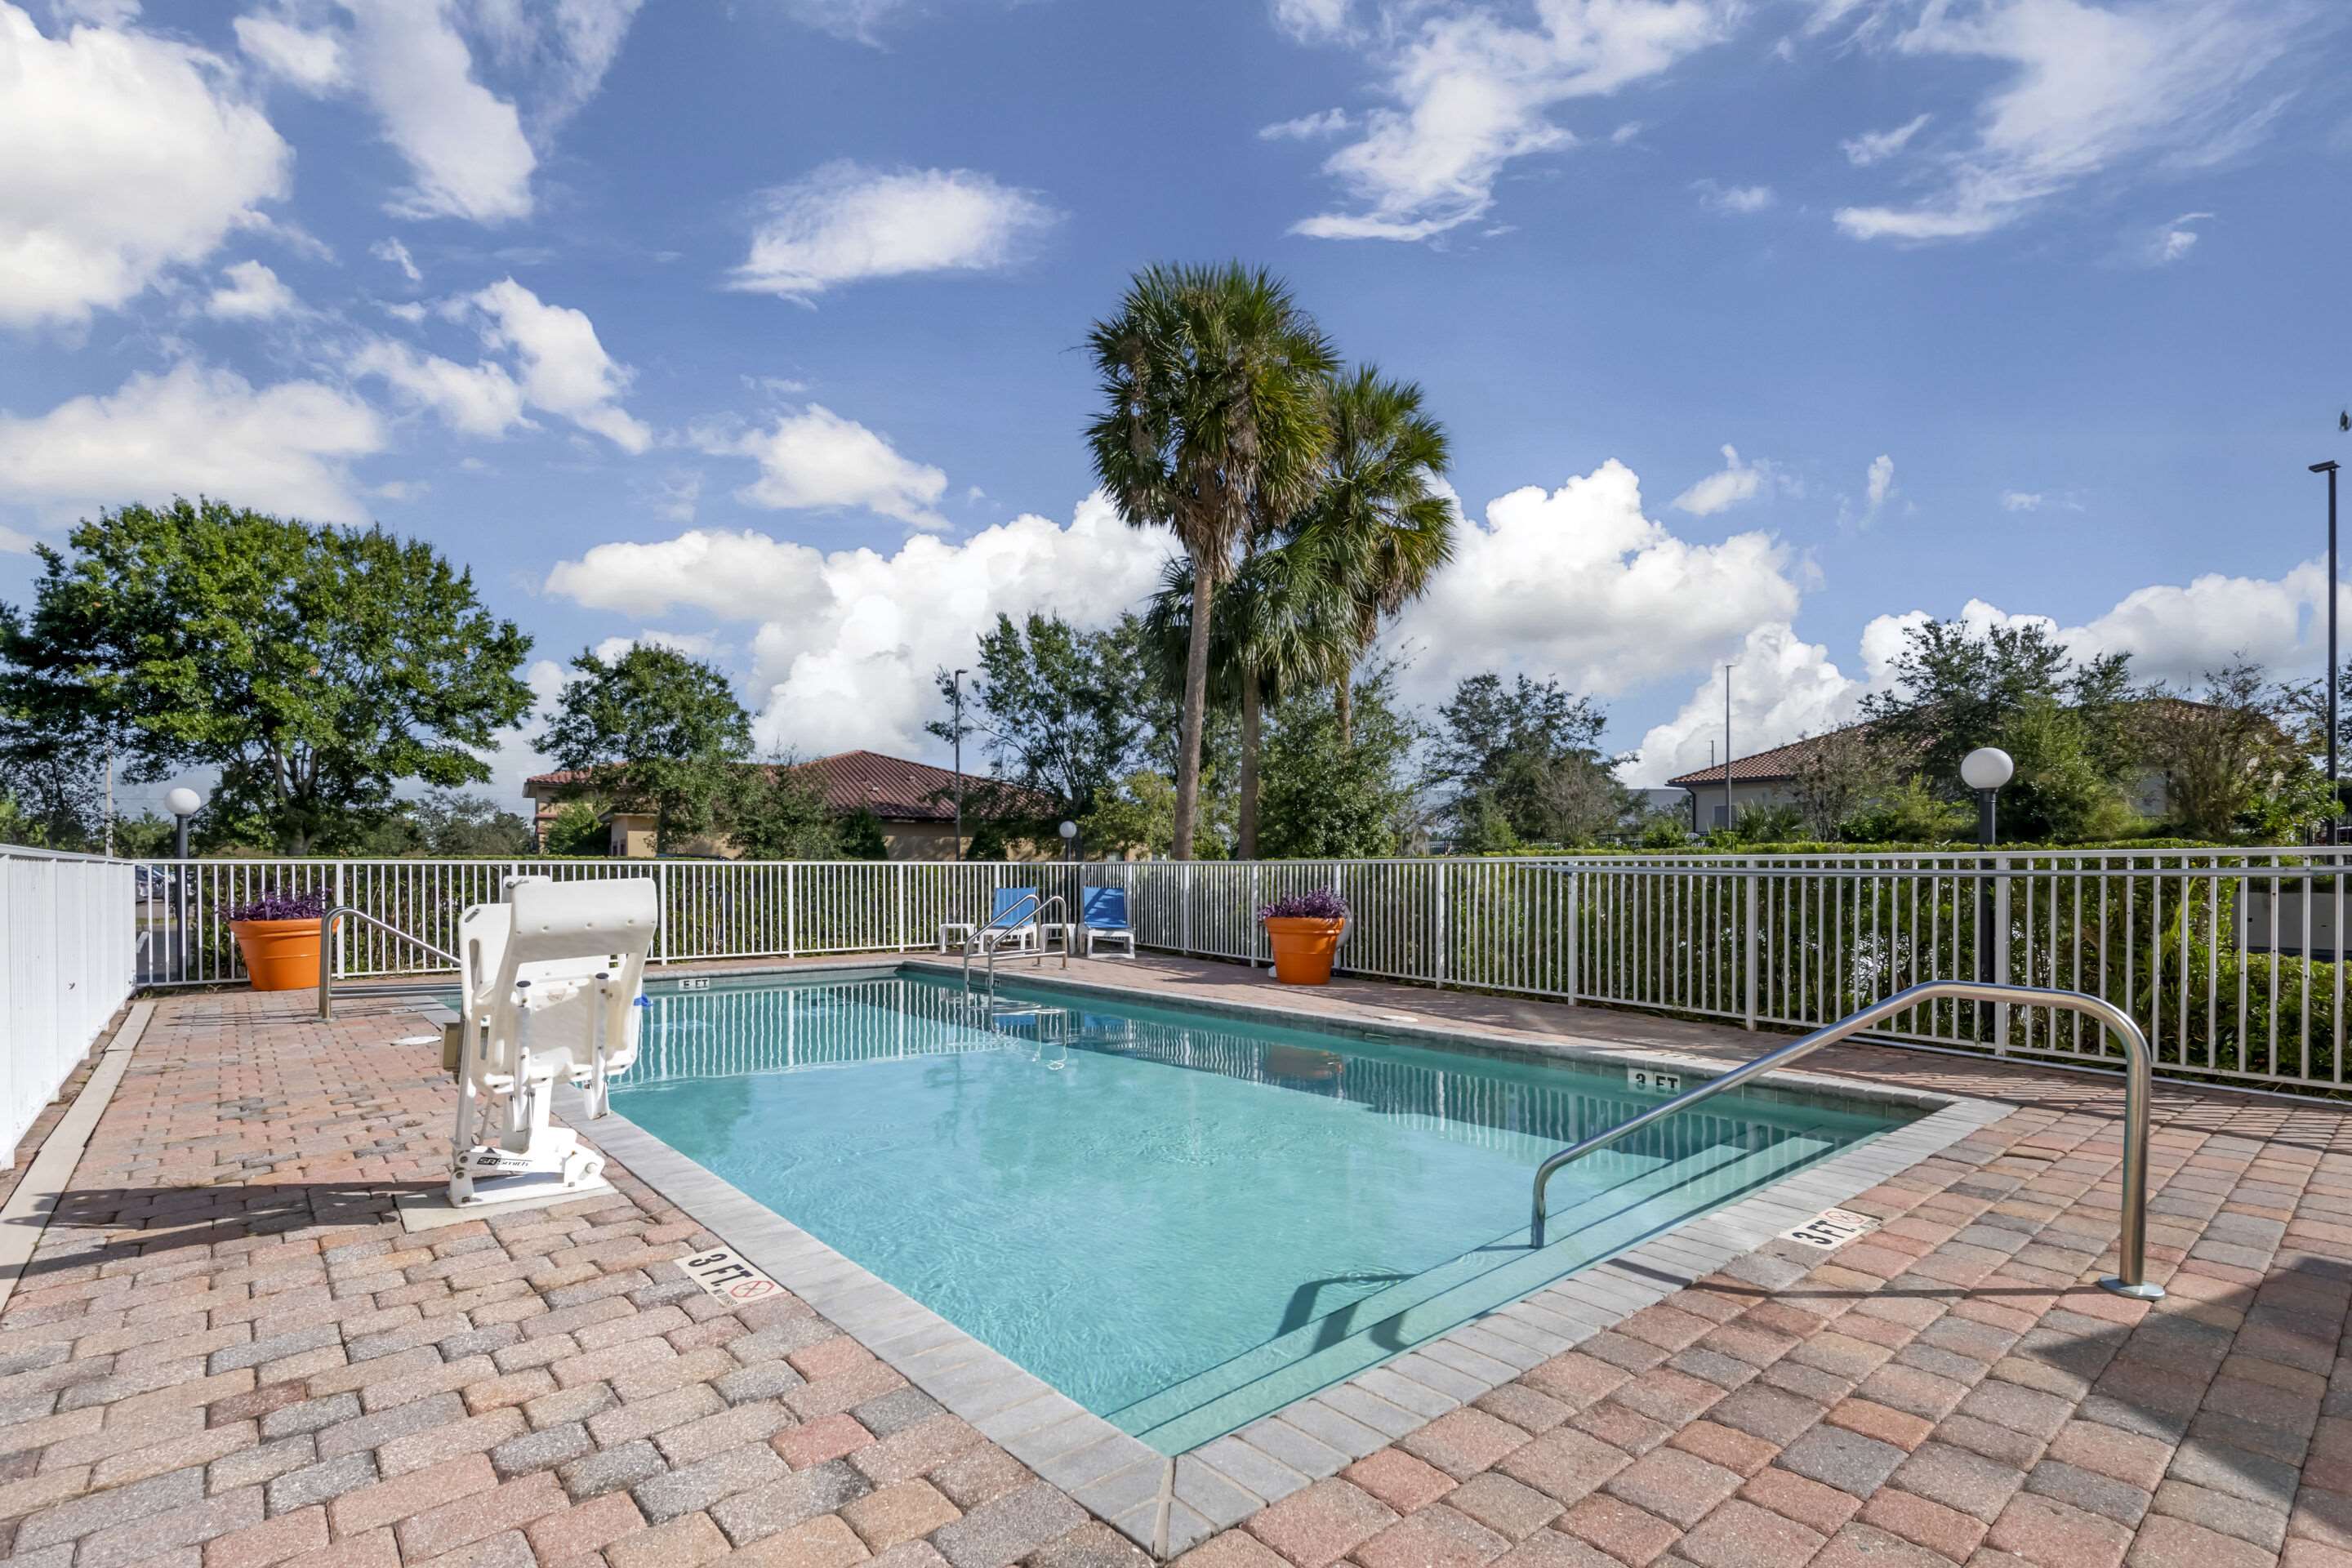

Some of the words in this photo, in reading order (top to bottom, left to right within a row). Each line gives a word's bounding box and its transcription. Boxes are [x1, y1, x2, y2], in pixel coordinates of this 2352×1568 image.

[695, 979, 708, 988] FT
[1655, 1075, 1678, 1089] FT
[1792, 1232, 1833, 1245] 3
[688, 1254, 728, 1267] 3
